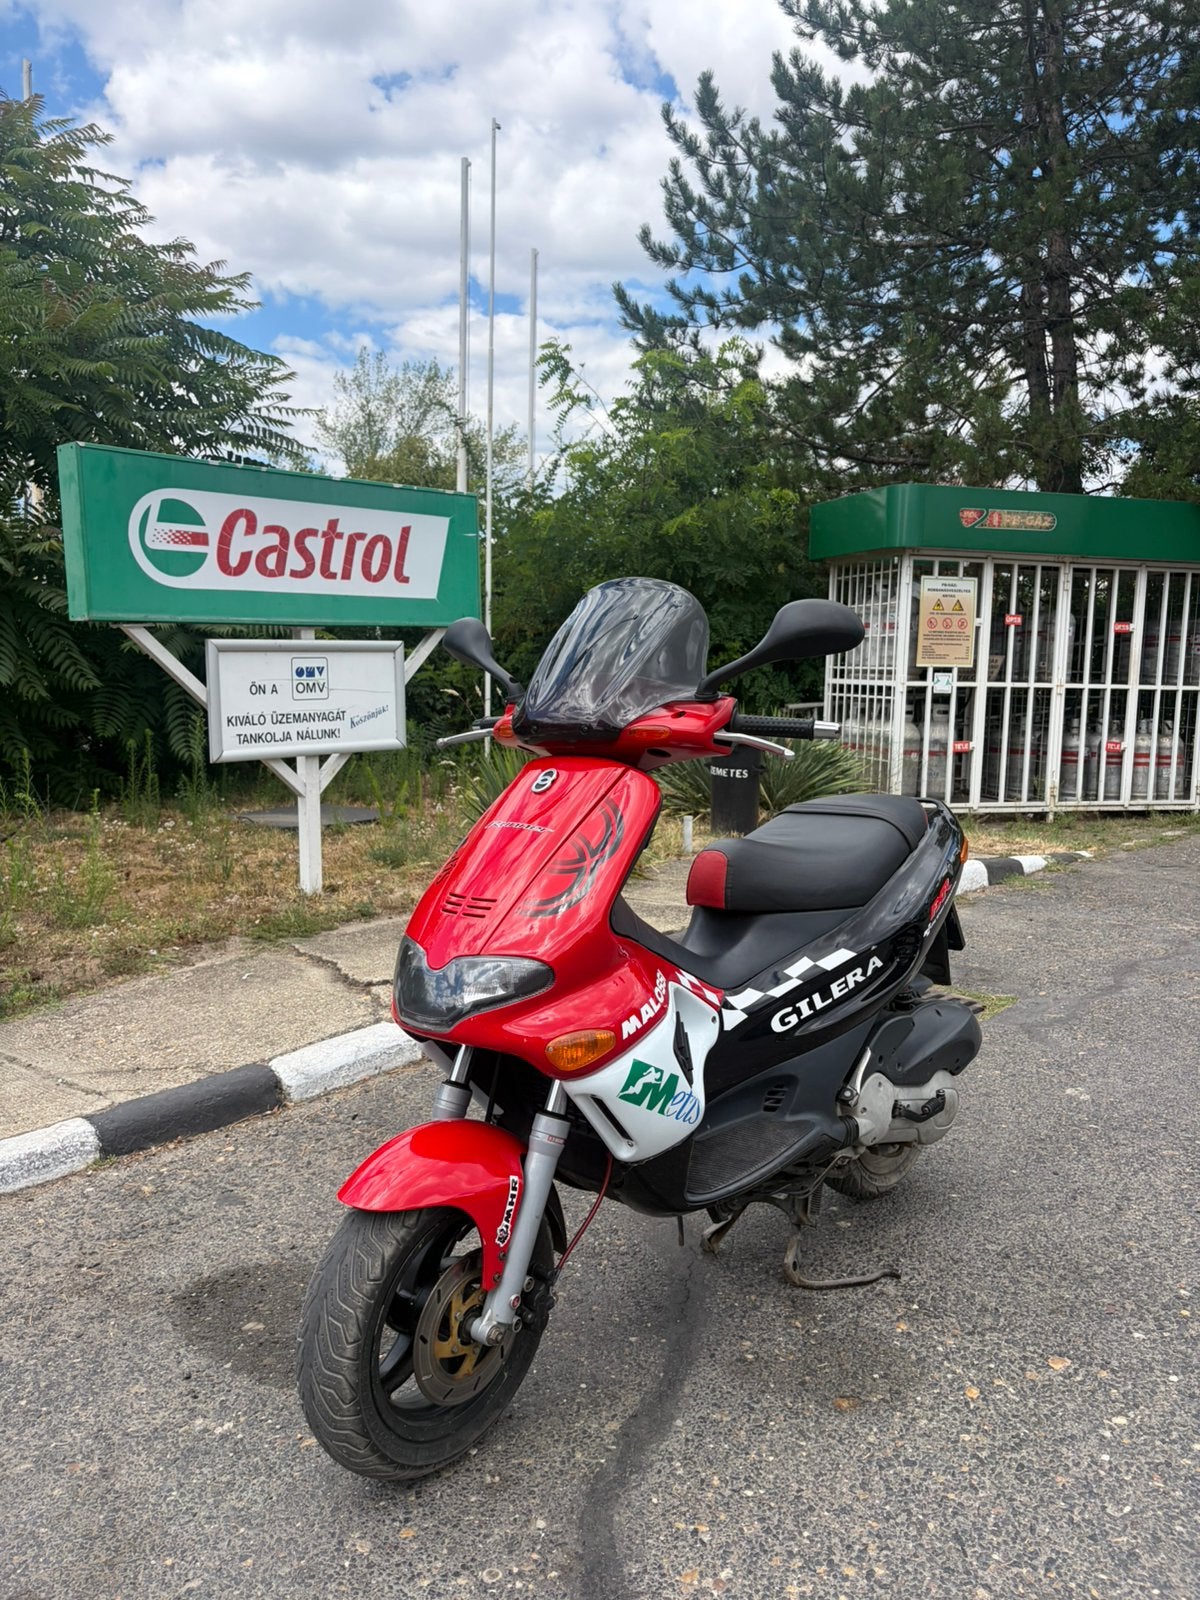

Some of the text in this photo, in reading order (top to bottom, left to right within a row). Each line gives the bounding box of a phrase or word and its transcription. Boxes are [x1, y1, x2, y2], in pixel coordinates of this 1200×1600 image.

[216, 508, 412, 585] Castrol
[249, 681, 326, 695] ÖN A OMV
[226, 709, 346, 727] KIVÁLÓ ÜZEMANYAGÁT
[236, 728, 341, 745] TANKOLJA NÁLUNK!
[621, 969, 667, 1040] MALOSSI
[770, 955, 884, 1033] GILERA
